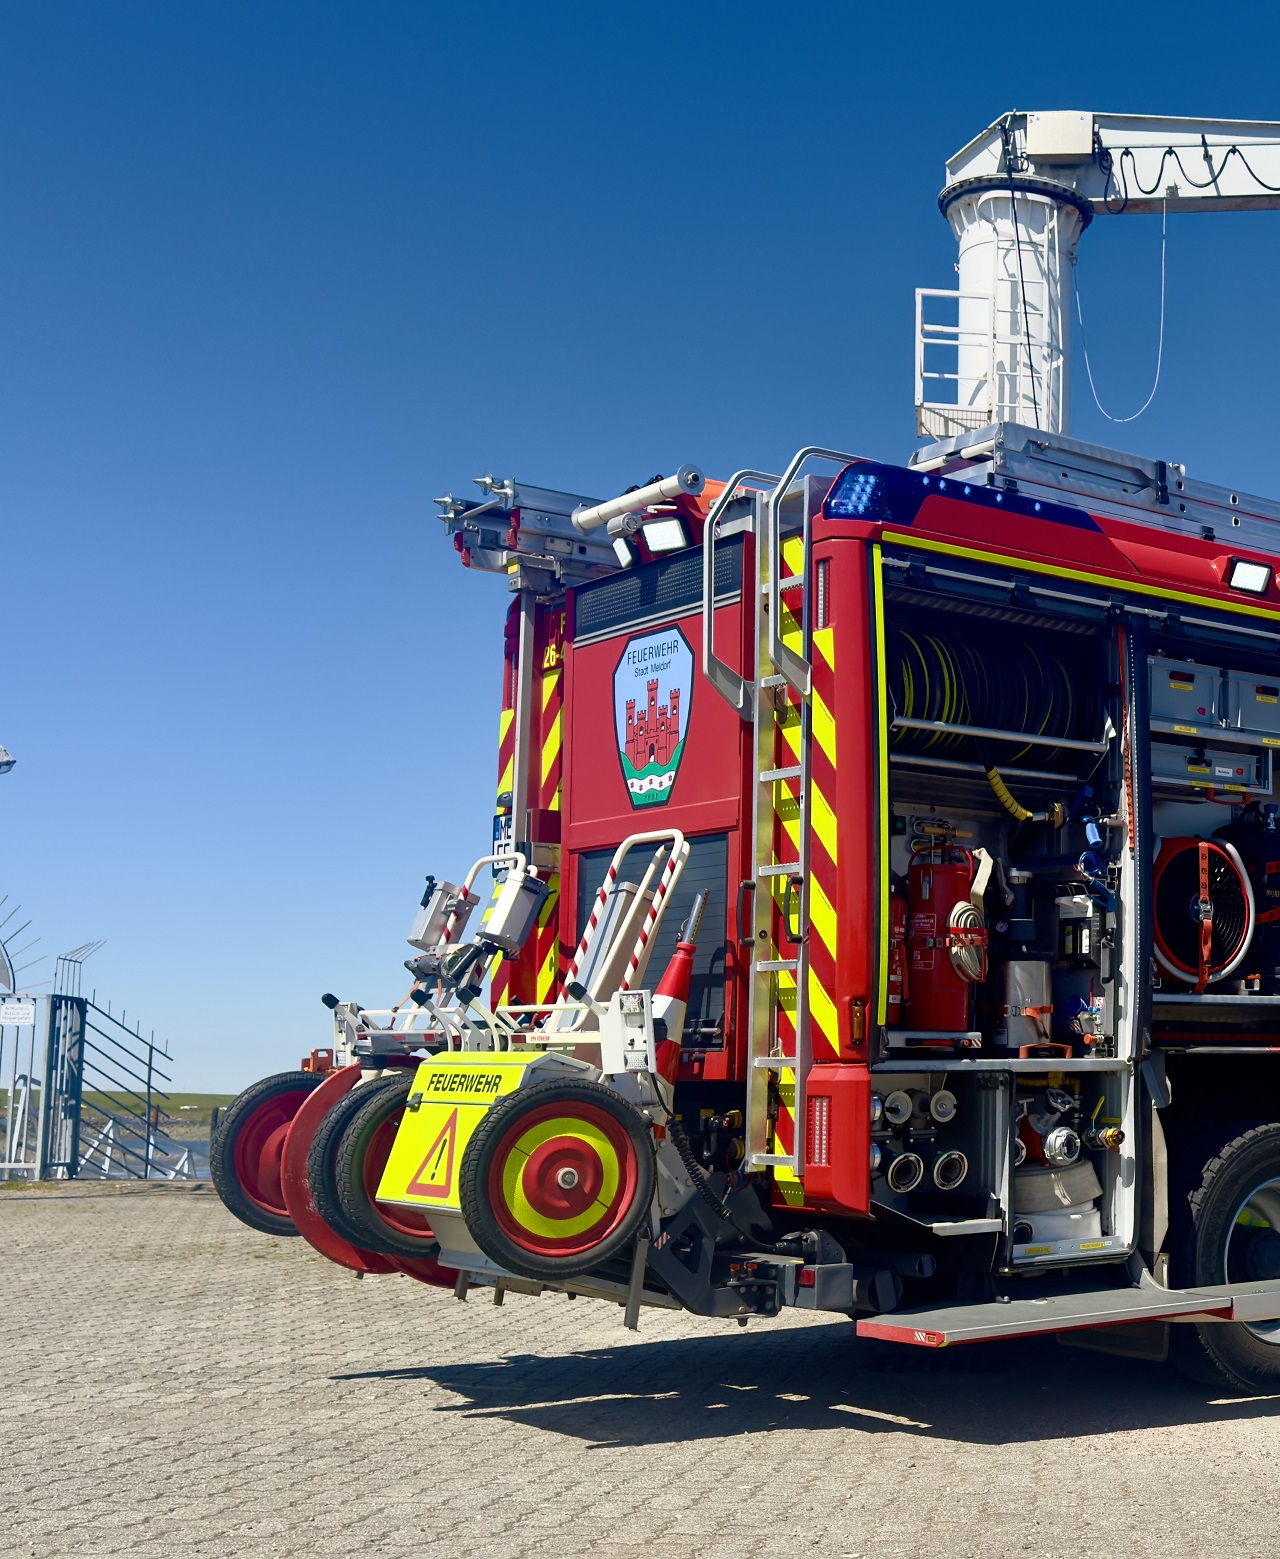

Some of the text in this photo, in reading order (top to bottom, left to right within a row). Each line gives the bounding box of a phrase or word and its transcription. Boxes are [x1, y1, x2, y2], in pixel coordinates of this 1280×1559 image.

[627, 639, 679, 665] FEUERWEHR
[634, 659, 671, 678] Stadt Meldorf
[427, 1073, 503, 1093] FEUERWEHR
